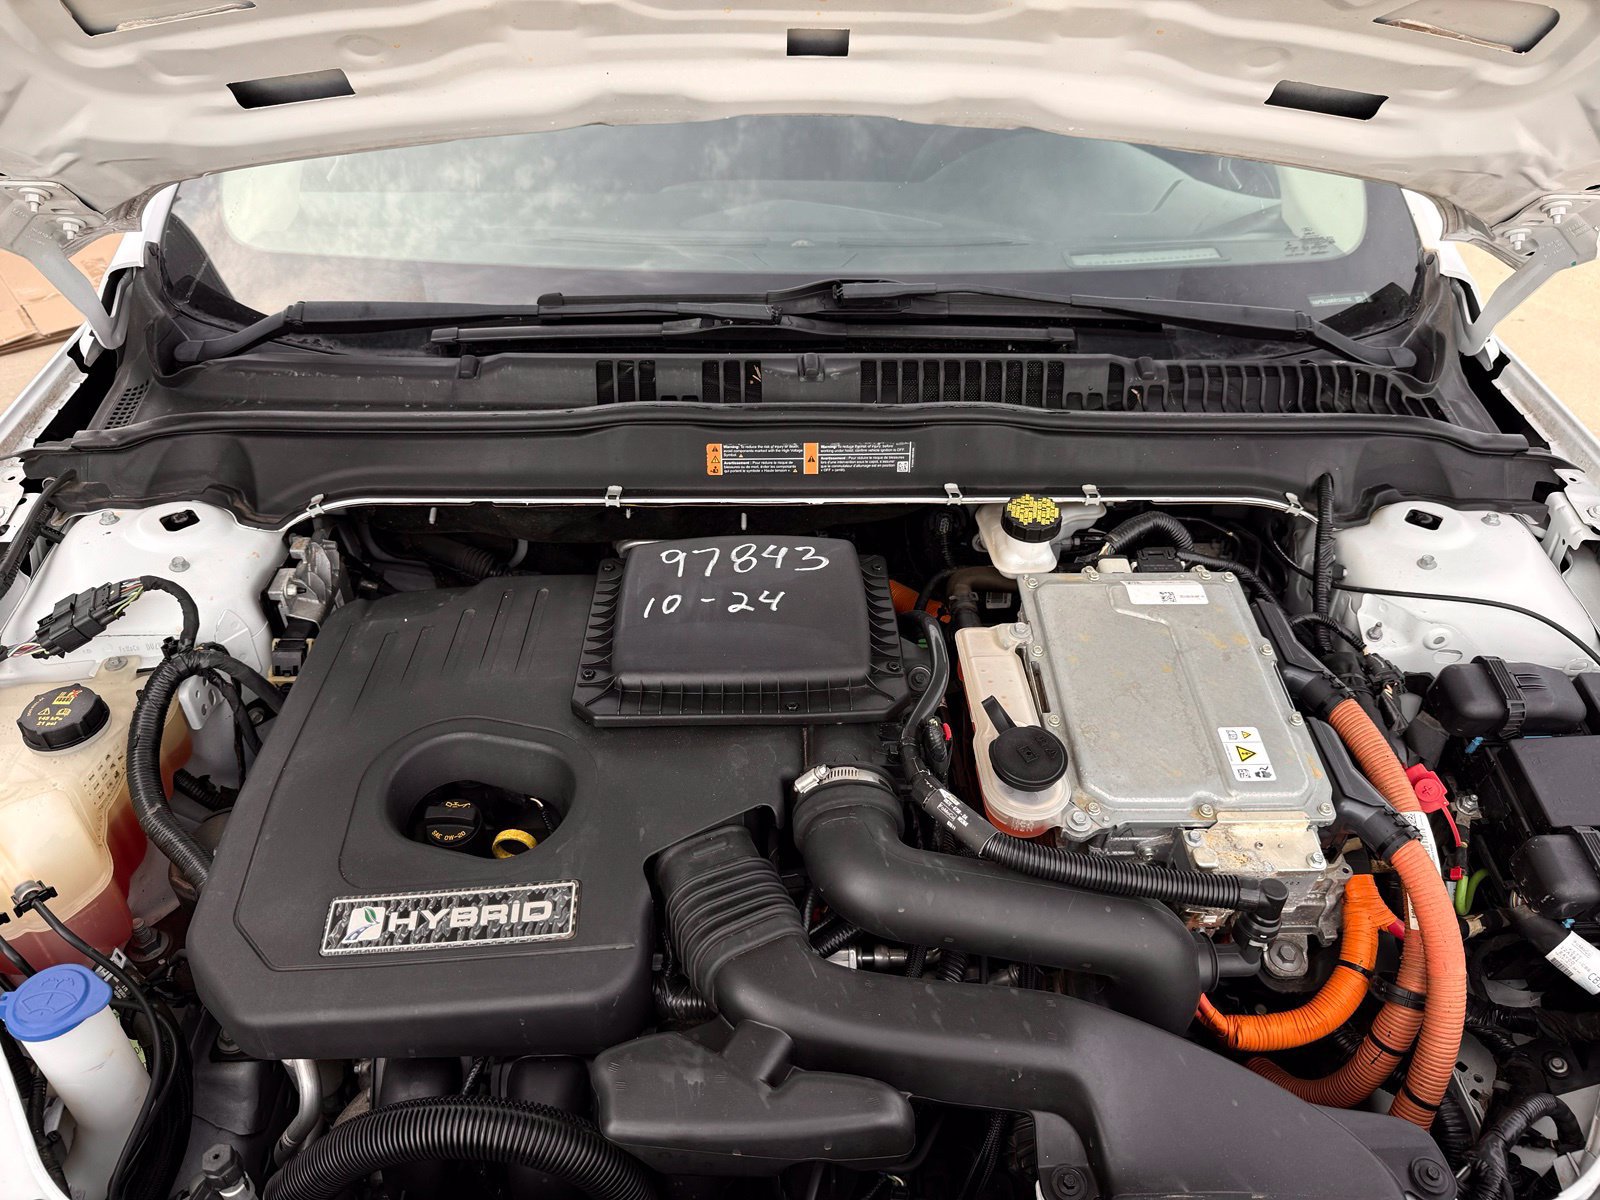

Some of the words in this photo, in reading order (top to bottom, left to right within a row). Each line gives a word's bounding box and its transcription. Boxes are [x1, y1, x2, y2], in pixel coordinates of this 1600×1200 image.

[660, 543, 830, 578] 97843
[643, 593, 682, 619] 10
[727, 590, 786, 613] 24
[431, 830, 443, 840] SAE
[388, 899, 555, 934] HYBRID
